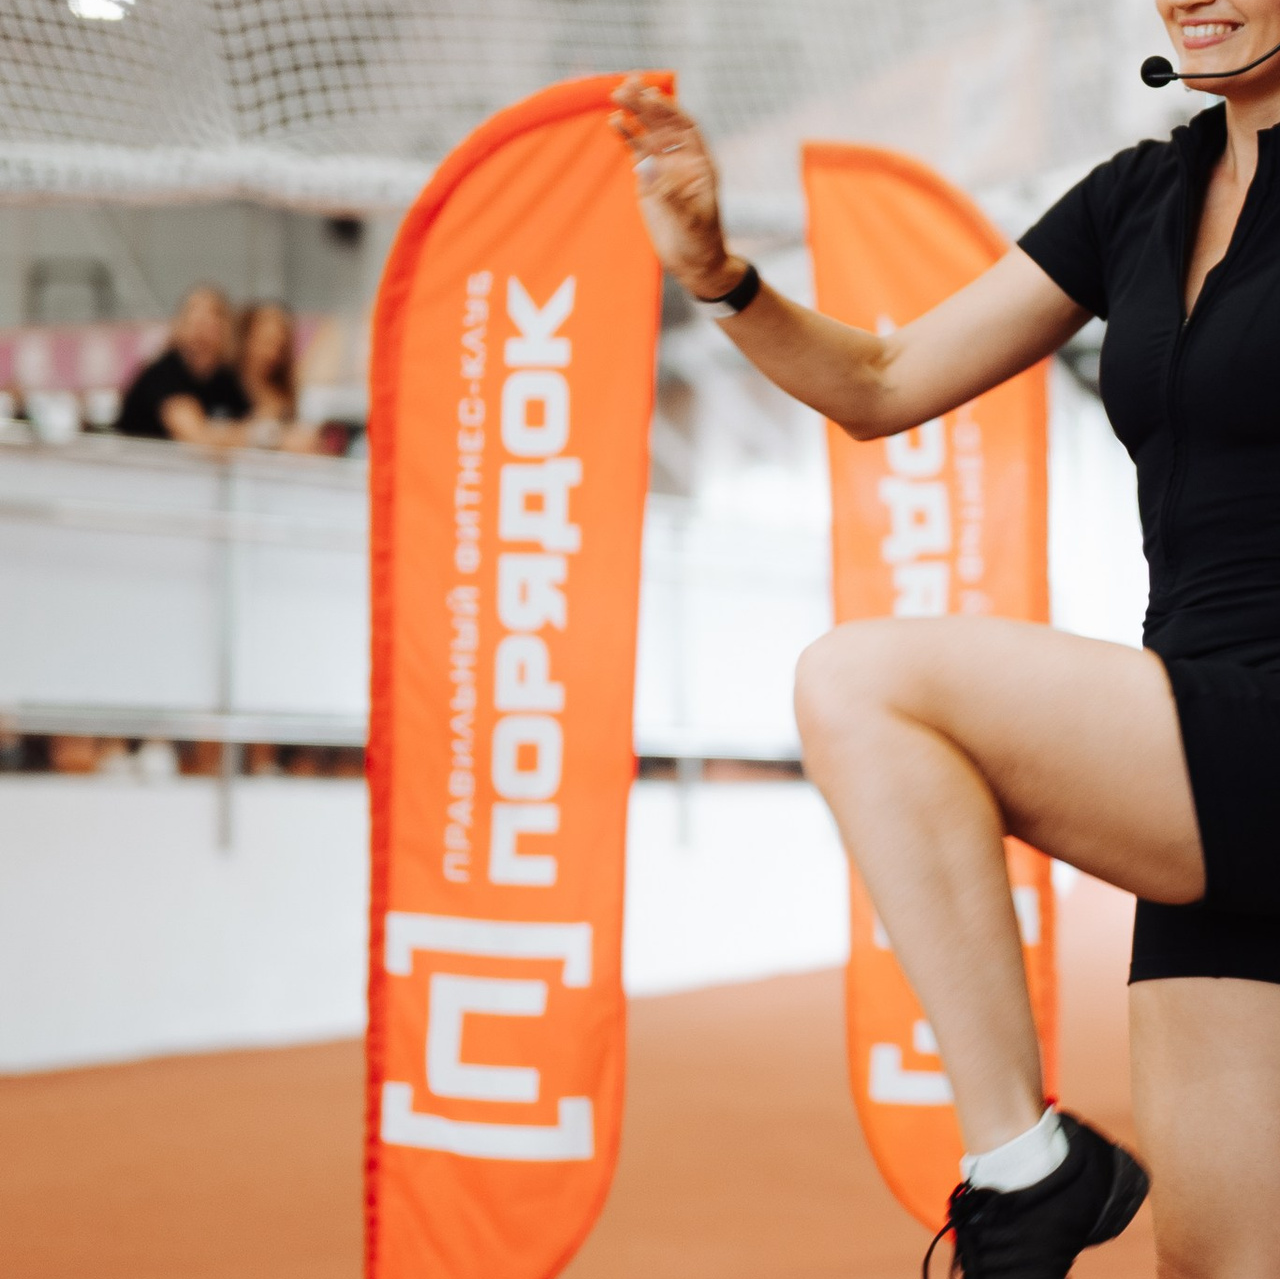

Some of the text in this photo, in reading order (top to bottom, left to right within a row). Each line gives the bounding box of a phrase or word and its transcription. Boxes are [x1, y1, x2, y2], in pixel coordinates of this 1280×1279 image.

[442, 270, 493, 883] ПРАВИЛЬНЫЙ ФИТНЕС-КЛУБ
[488, 275, 583, 888] ПОРЯДОК
